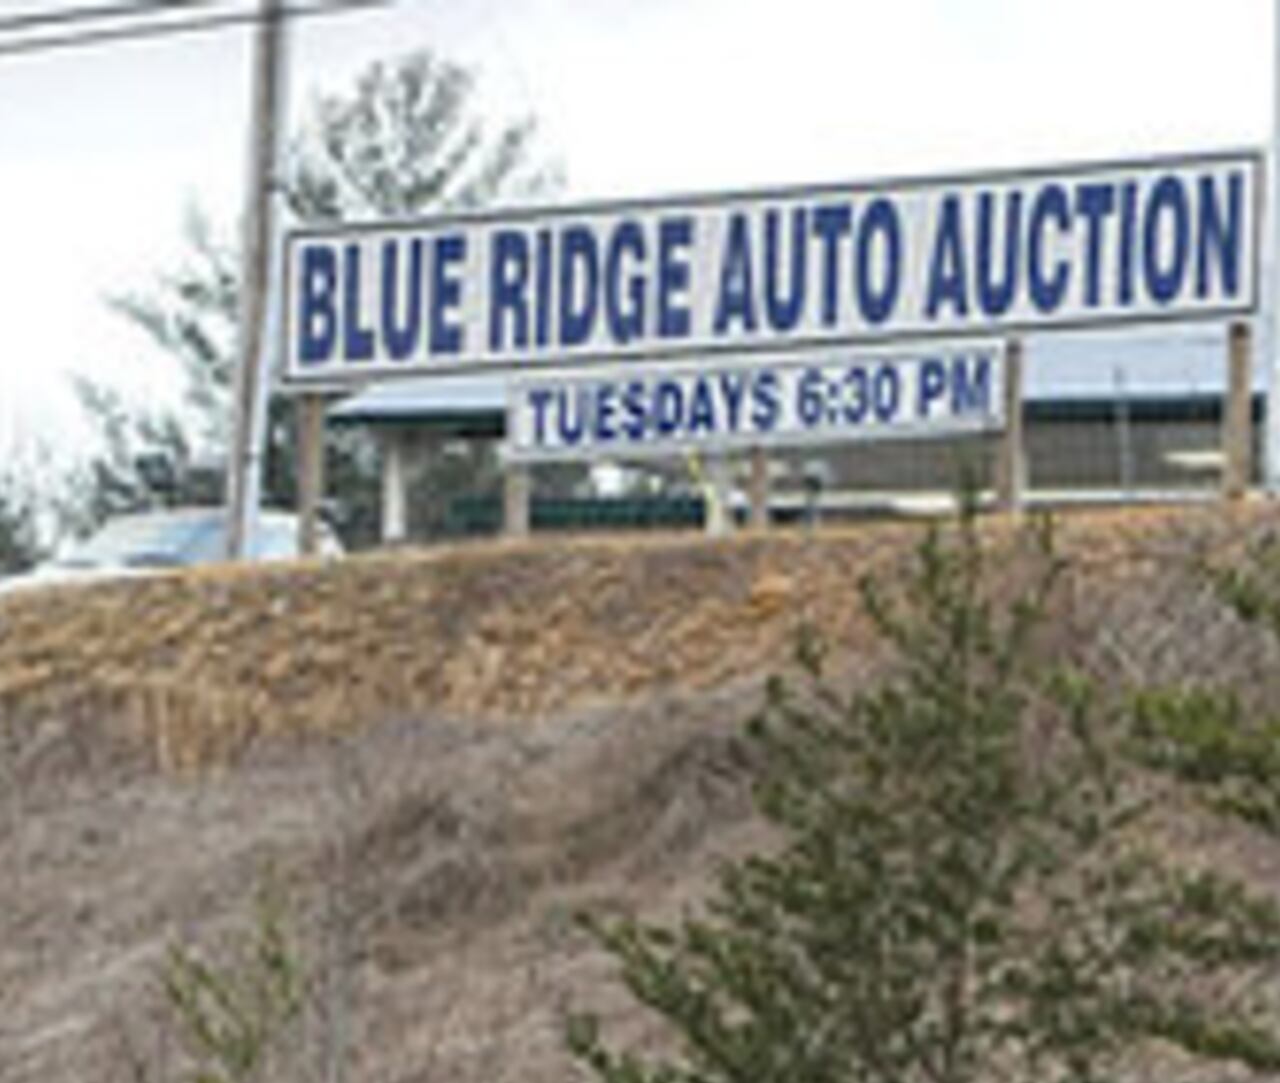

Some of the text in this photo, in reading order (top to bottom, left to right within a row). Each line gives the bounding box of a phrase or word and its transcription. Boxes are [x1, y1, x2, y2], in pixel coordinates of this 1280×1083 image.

[299, 172, 1242, 364] BLUE RIDGE AUTO AUCTION
[529, 355, 991, 445] TUESDAYS 6:30 PM
